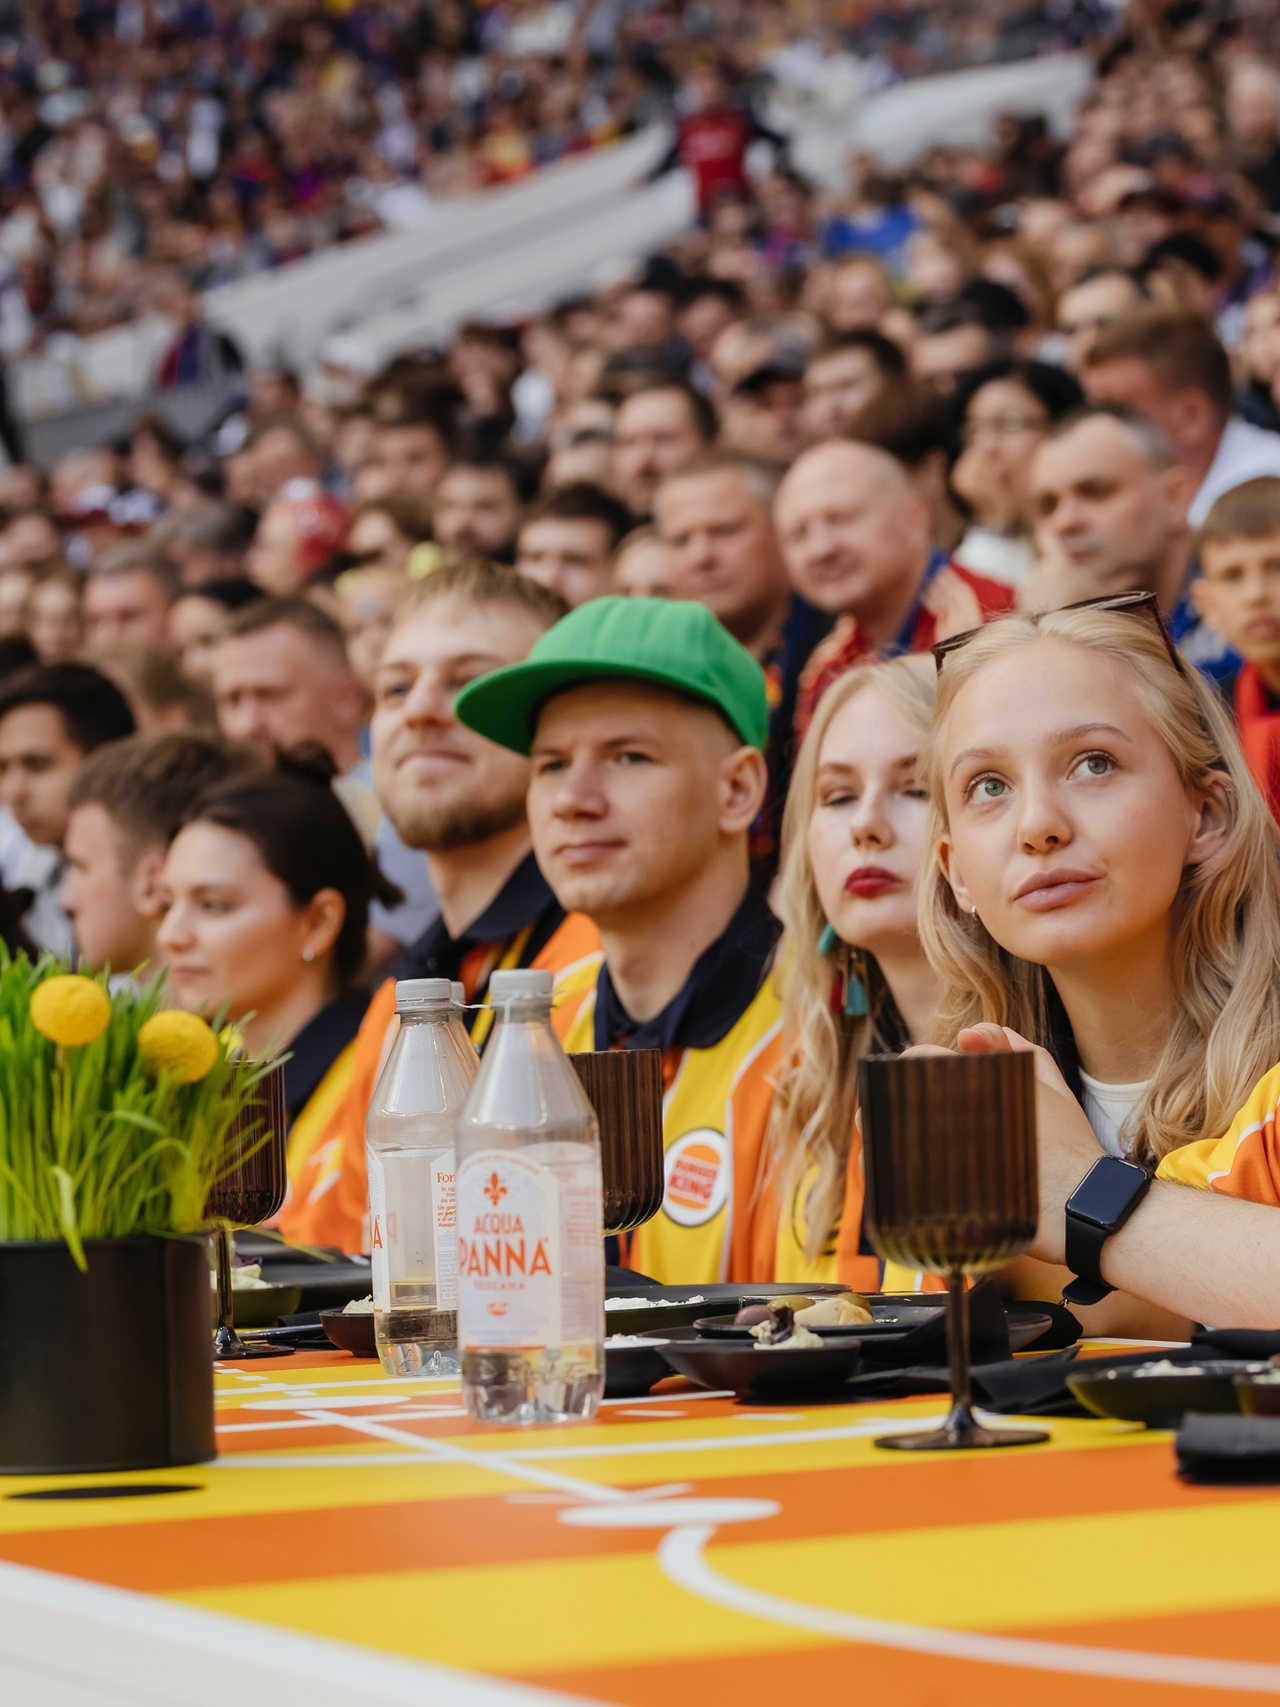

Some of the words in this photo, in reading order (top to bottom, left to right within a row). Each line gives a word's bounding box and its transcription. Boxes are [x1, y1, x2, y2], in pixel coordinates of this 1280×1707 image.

[675, 1160, 718, 1180] BURGER
[669, 1174, 713, 1199] KING
[474, 1213, 524, 1235] ACQUA
[458, 1237, 552, 1276] PANNA
